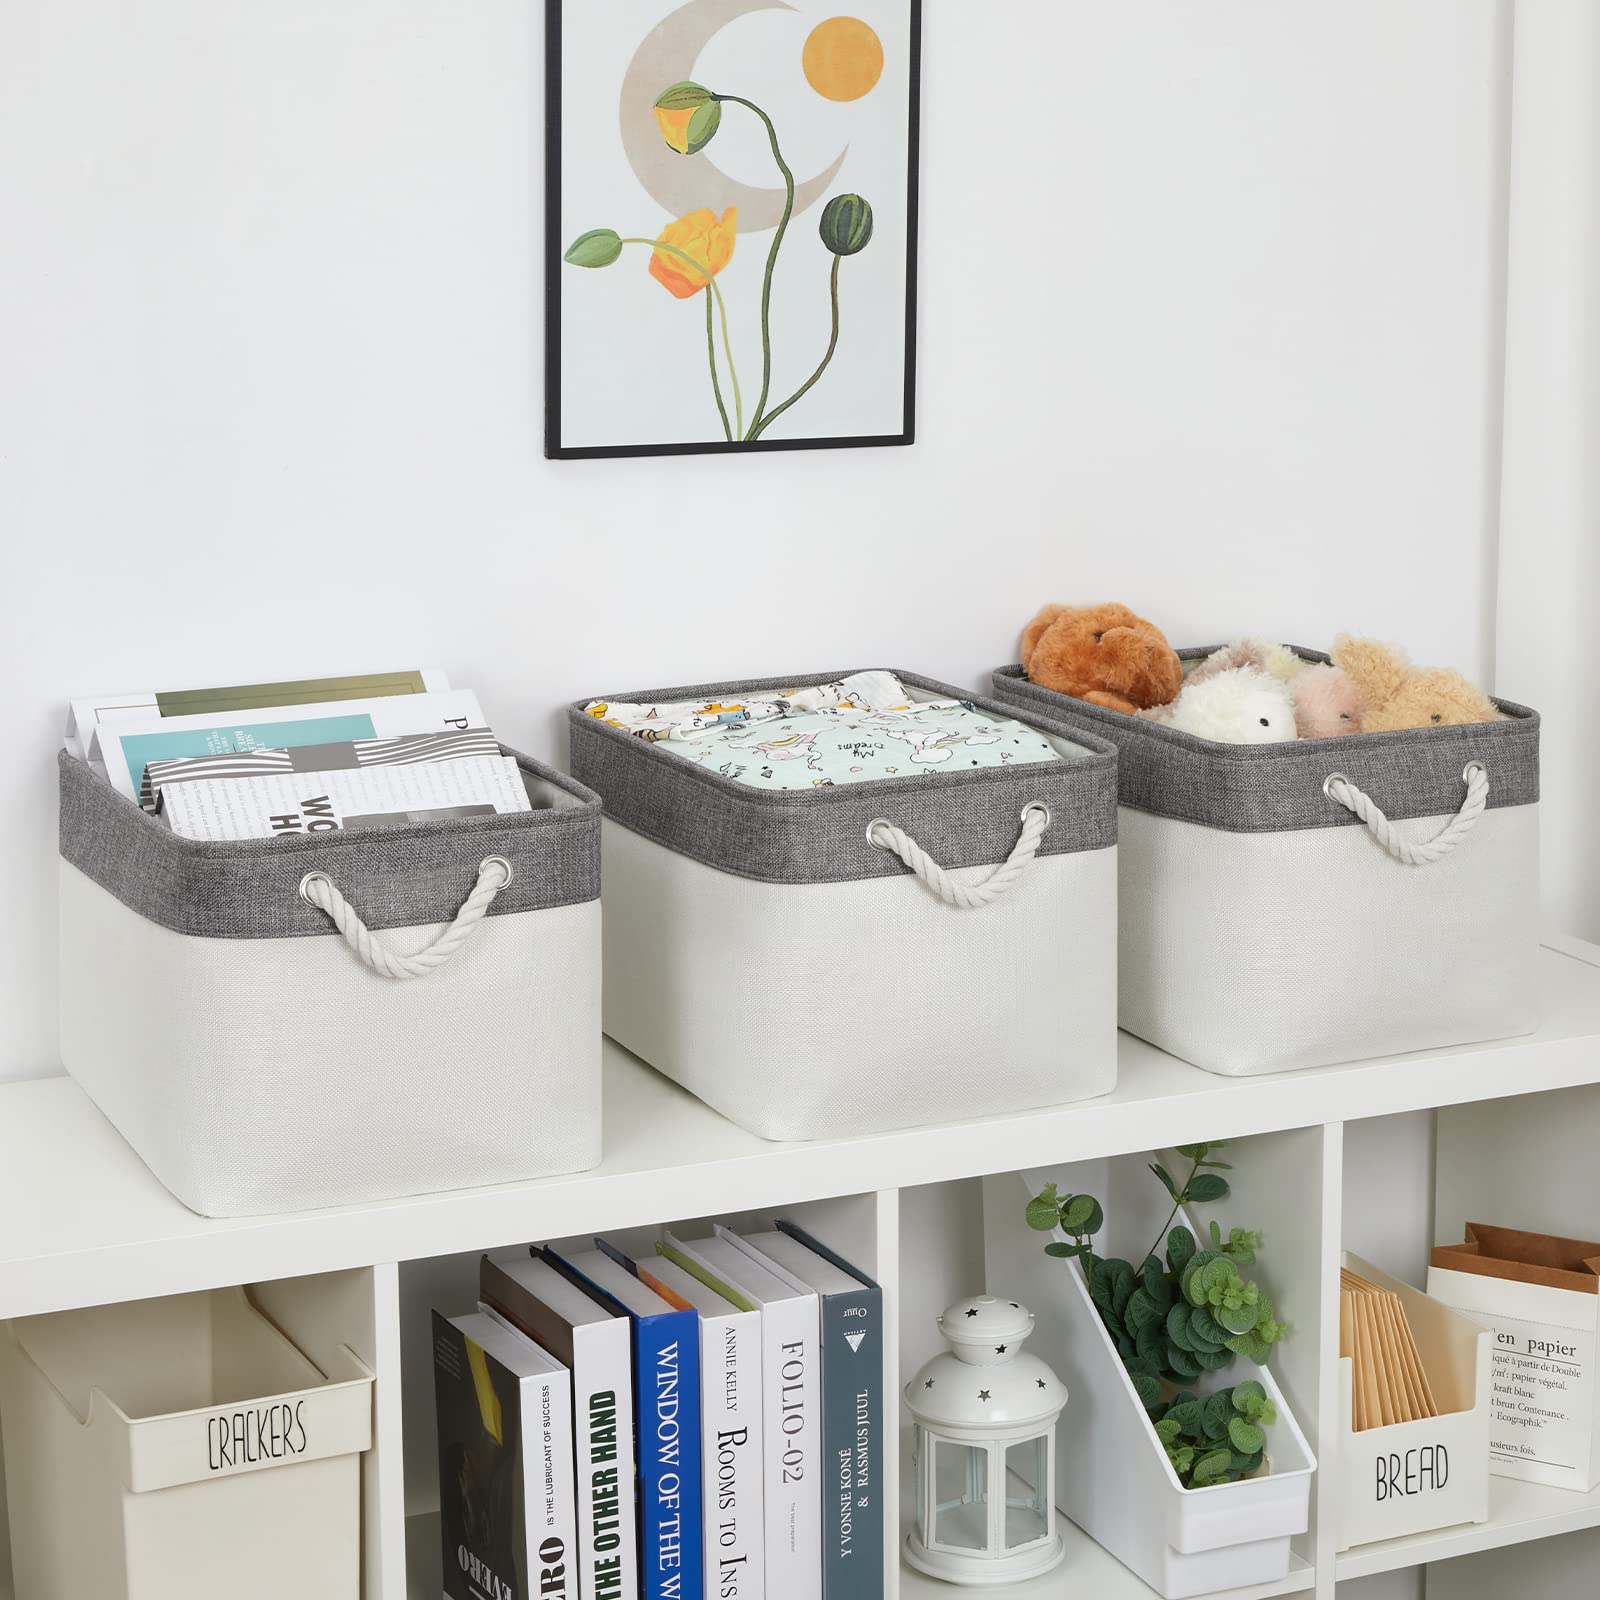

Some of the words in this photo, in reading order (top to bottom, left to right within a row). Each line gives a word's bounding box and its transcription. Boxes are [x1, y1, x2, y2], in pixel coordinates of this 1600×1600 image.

[837, 742, 884, 750] Dreams
[852, 749, 875, 759] My
[269, 814, 303, 837] H
[725, 1327, 737, 1368] ANNIE
[1497, 1332, 1515, 1345] en
[1527, 1339, 1577, 1357] papier
[1511, 1371, 1537, 1384] papier
[1517, 1358, 1540, 1370] partir
[1540, 1363, 1551, 1372] de
[1551, 1364, 1581, 1378] Double
[541, 1385, 551, 1428] SUCCESS
[657, 1341, 680, 1466] WINDOW
[726, 1370, 737, 1412] KELLY
[857, 1389, 871, 1425] JUUL
[1493, 1382, 1513, 1395] kraft
[1514, 1386, 1535, 1399] blanc
[1496, 1398, 1516, 1410] brun
[208, 1400, 307, 1470] CRACKERS
[543, 1430, 552, 1442] OF
[589, 1390, 617, 1464] HAND
[839, 1447, 852, 1490] KONÉ
[857, 1428, 869, 1487] RASMUS
[1519, 1444, 1536, 1456] fois.
[545, 1446, 554, 1496] LUBRICANT
[1376, 1444, 1449, 1501] BREAD
[546, 1497, 555, 1516] THE
[591, 1467, 621, 1552] OTHER
[657, 1472, 681, 1510] OF
[857, 1496, 869, 1508] &
[547, 1516, 555, 1526] IS
[659, 1513, 681, 1570] THE
[538, 1536, 566, 1600] RO
[594, 1555, 622, 1600] THE
